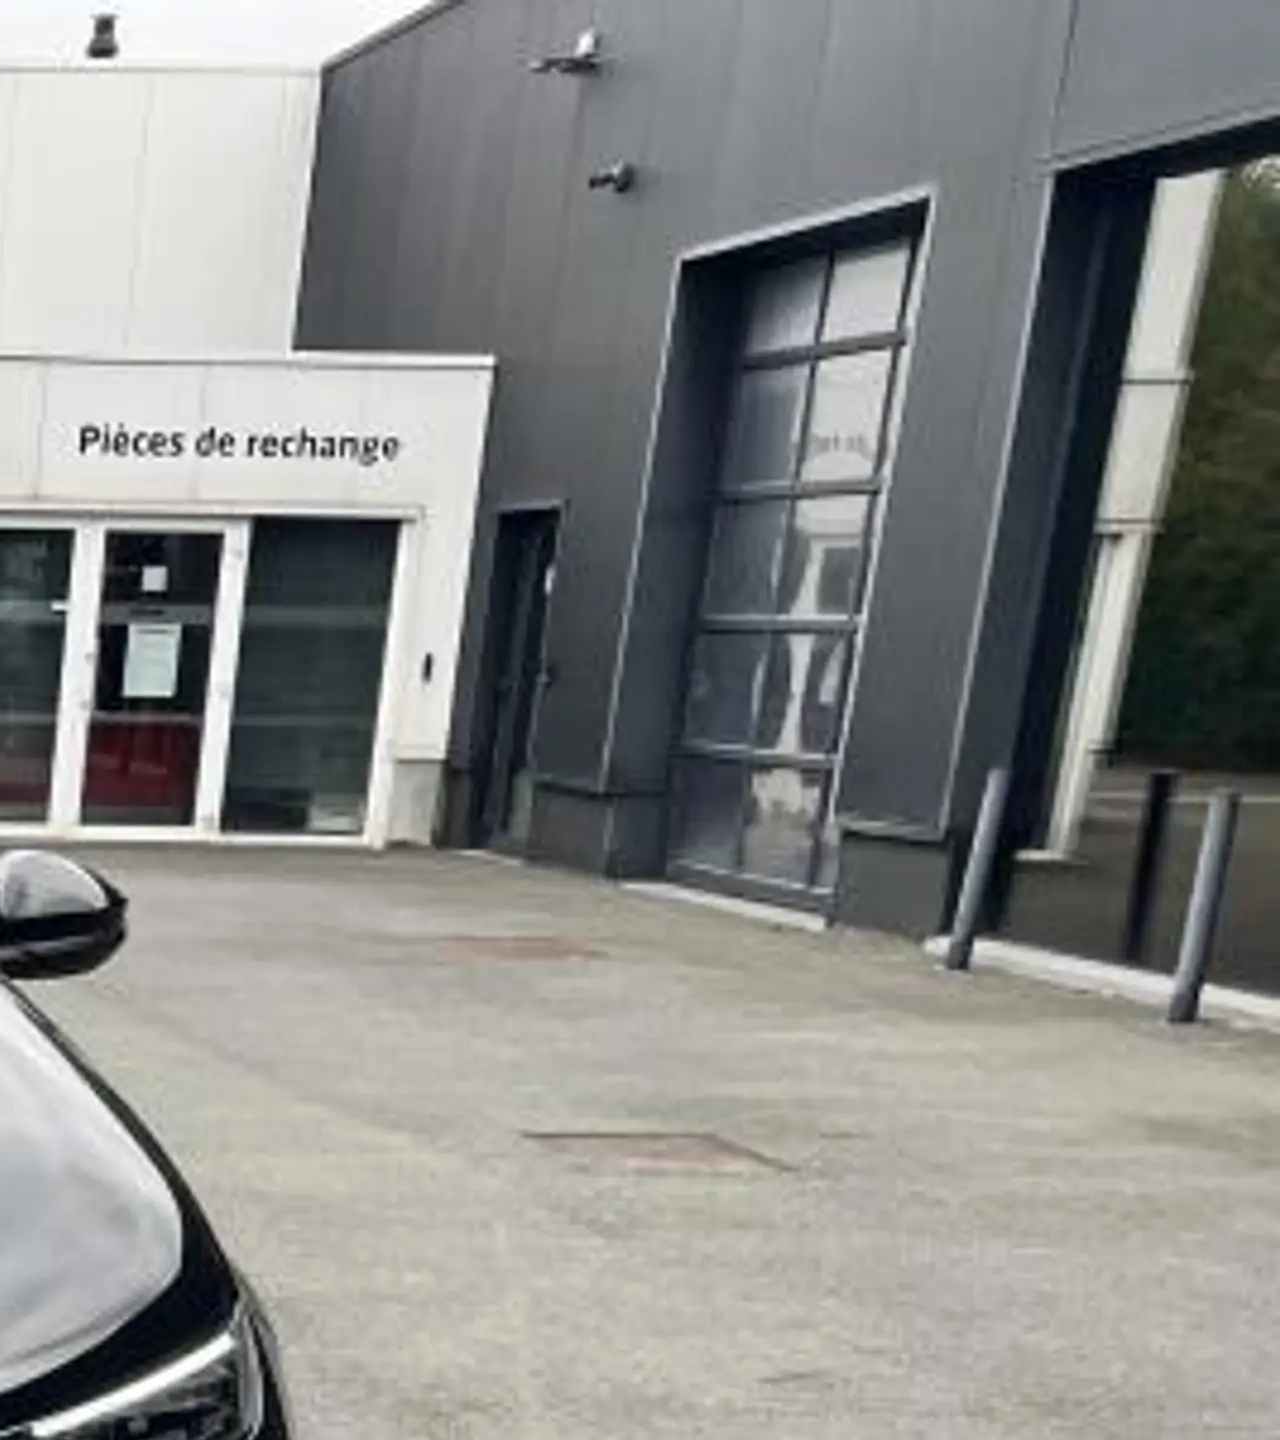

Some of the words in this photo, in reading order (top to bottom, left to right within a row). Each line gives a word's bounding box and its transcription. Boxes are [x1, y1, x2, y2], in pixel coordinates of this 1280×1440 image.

[78, 422, 186, 457] Pièces
[194, 426, 236, 458] de
[245, 426, 401, 467] rechange
